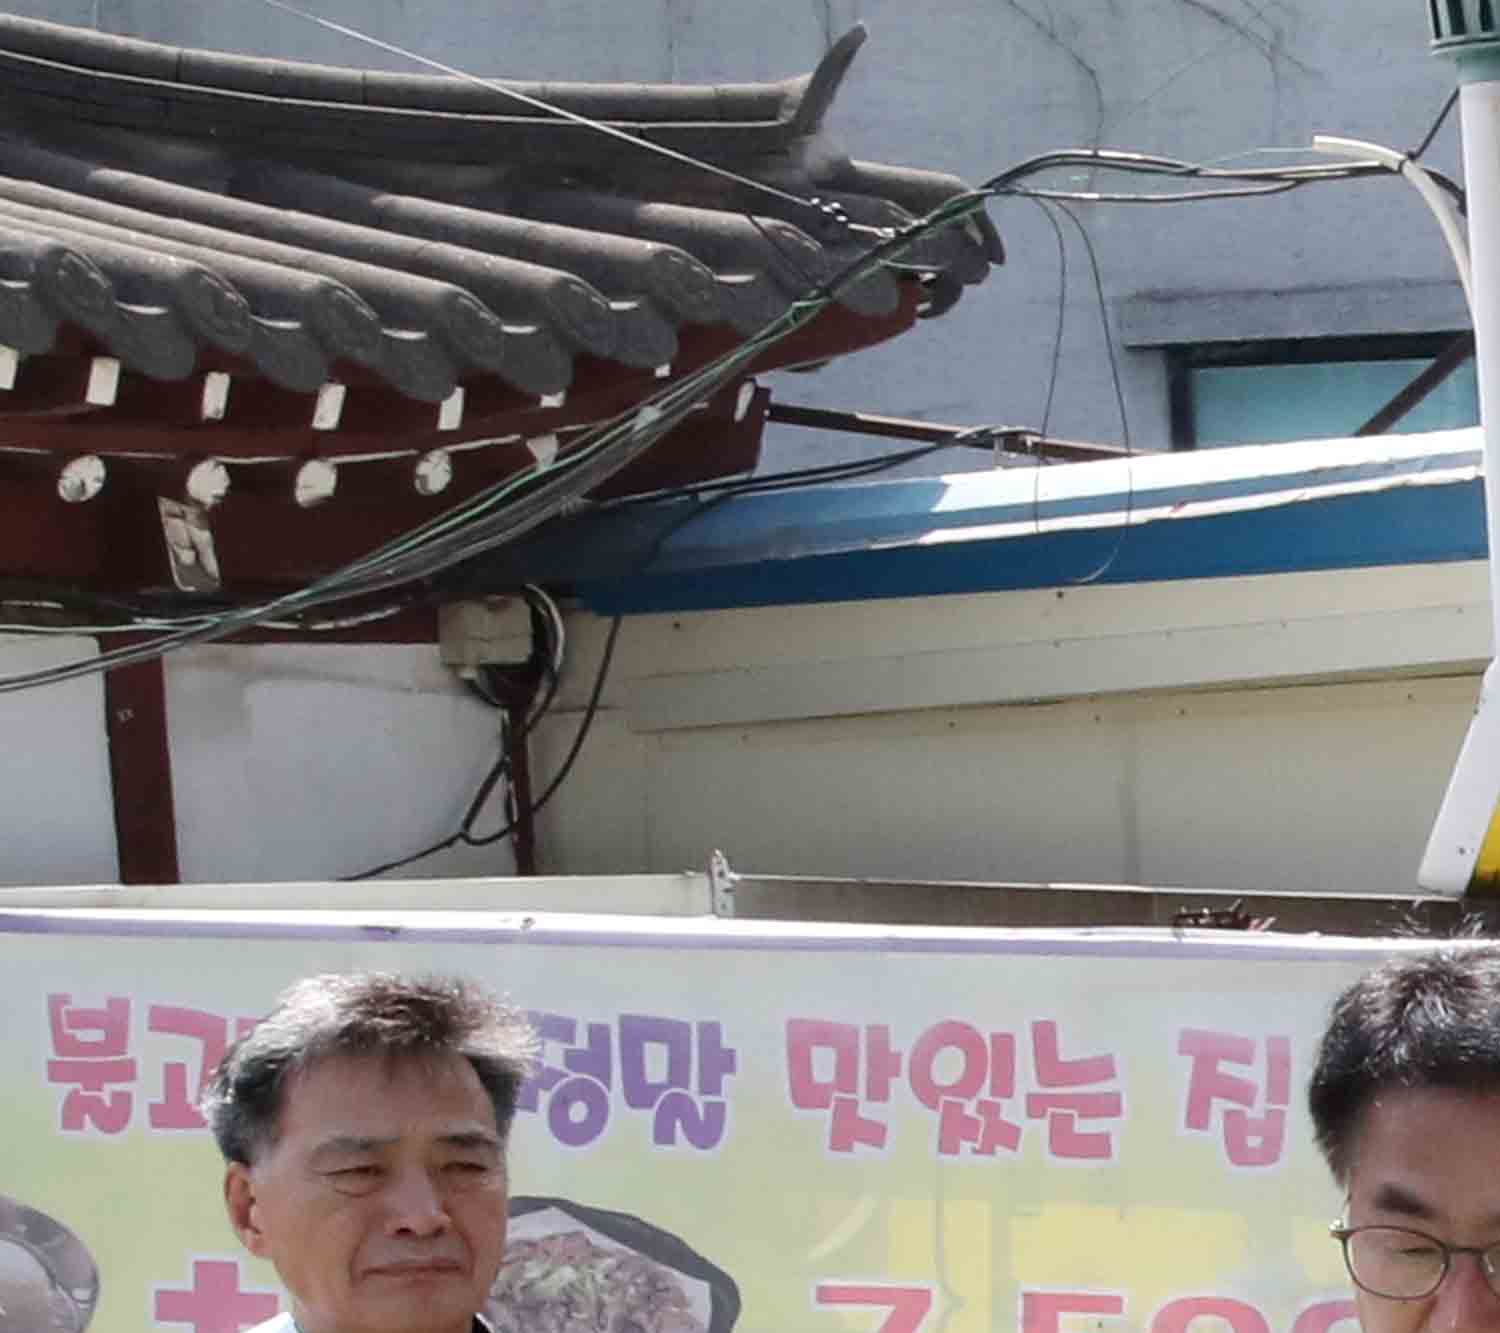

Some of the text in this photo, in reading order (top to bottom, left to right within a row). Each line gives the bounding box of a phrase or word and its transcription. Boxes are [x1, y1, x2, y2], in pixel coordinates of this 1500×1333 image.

[47, 993, 255, 1134] 불고
[786, 1018, 1123, 1160] 맛있는
[1177, 1027, 1291, 1167] 집
